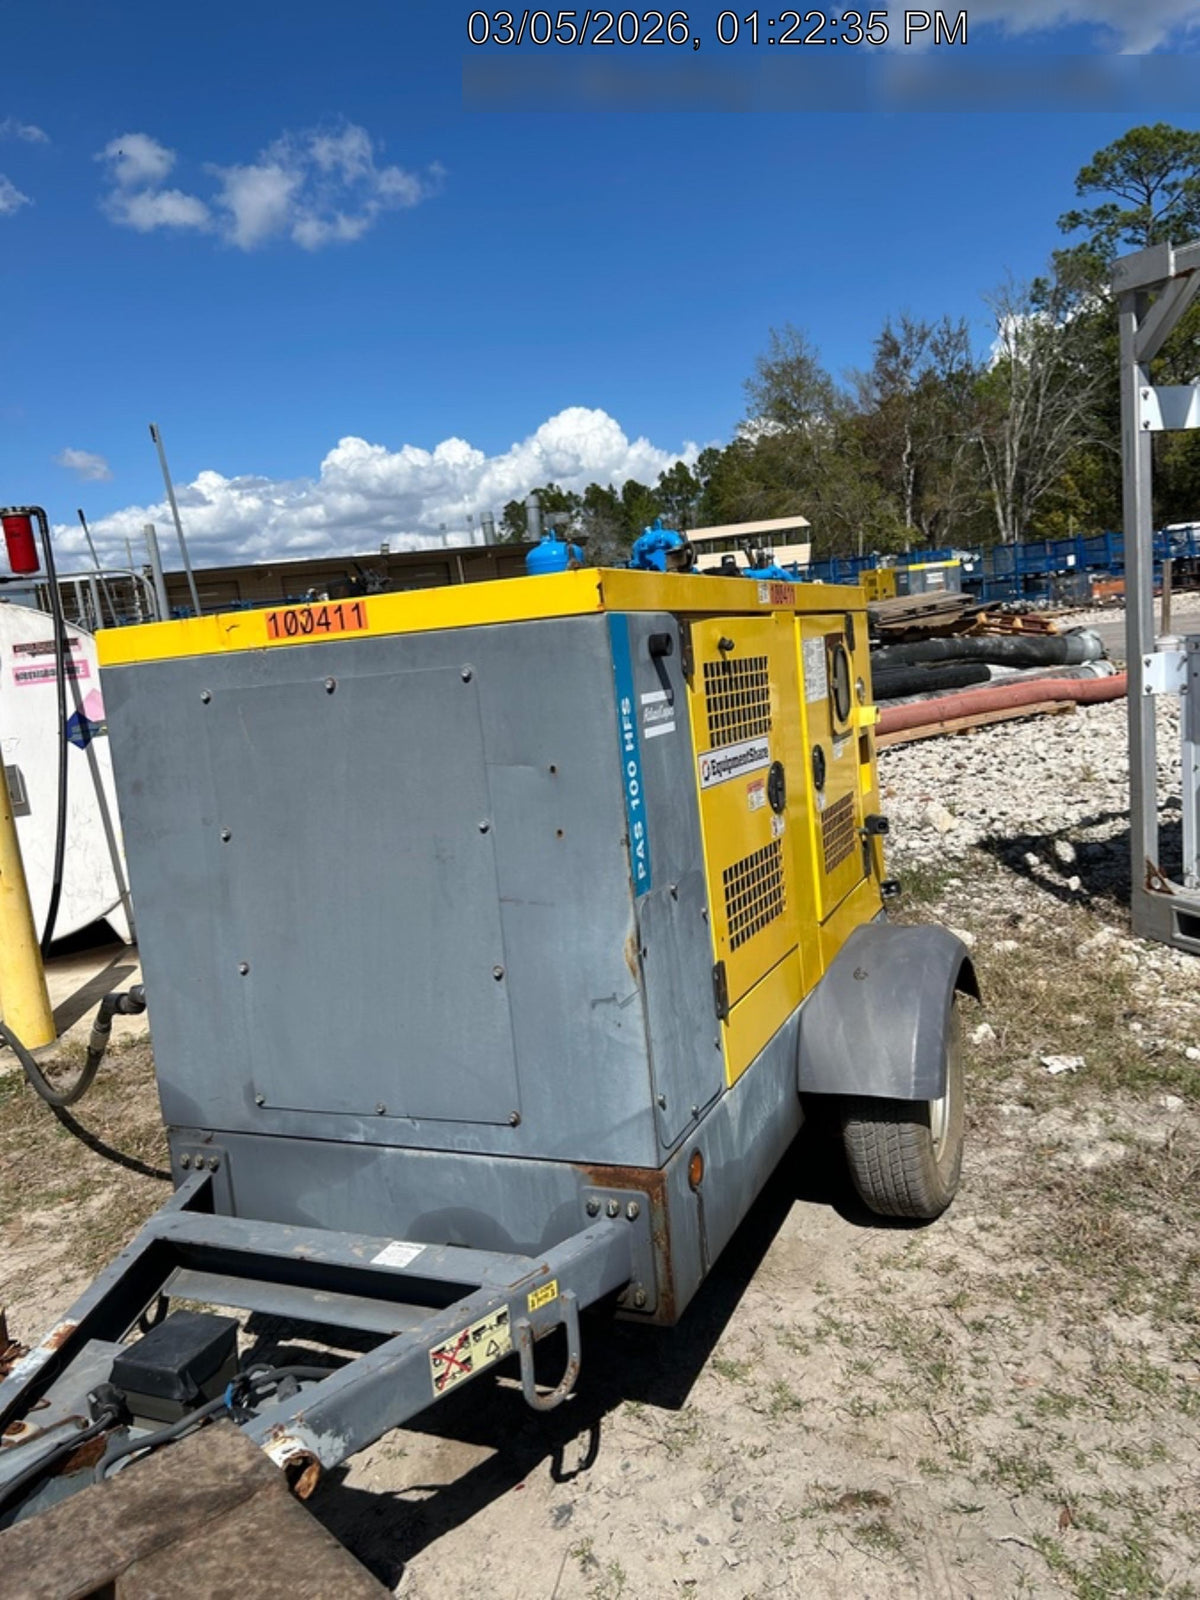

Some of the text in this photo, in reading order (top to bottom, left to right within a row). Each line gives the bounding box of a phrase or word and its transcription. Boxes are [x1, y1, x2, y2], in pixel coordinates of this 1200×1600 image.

[268, 601, 363, 637] 100411
[710, 746, 769, 777] EquipmentShare
[621, 697, 647, 880] PAS 100 HFS
